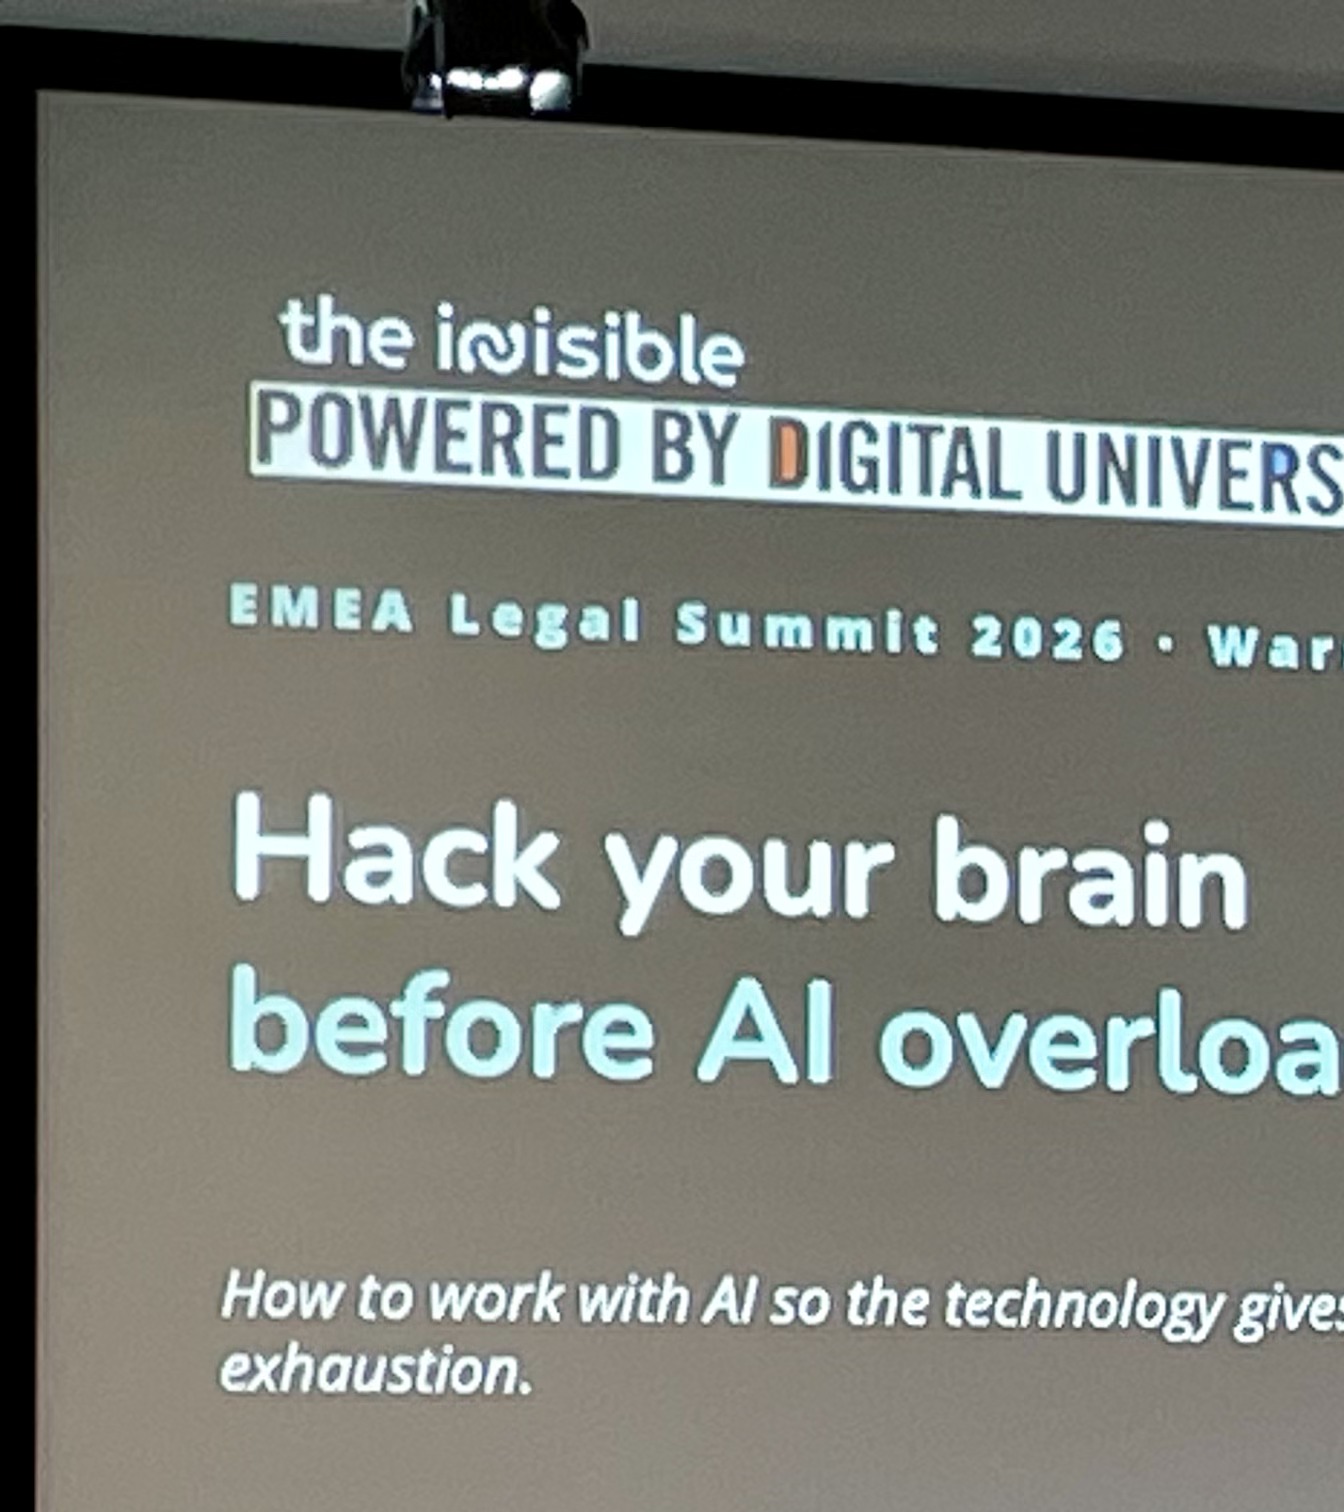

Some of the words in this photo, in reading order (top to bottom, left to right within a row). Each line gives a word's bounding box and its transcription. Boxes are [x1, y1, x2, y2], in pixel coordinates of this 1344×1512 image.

[278, 293, 416, 370] the
[256, 391, 619, 480] POWERED
[652, 408, 740, 485] BY
[769, 416, 1022, 500] DIGITAL
[229, 582, 414, 633] EMEA
[450, 592, 639, 651] Legal
[676, 601, 939, 655] Summit
[971, 614, 1124, 662] 2026
[234, 790, 562, 911] Hack
[603, 832, 897, 938] your
[935, 813, 1248, 931] brain
[231, 962, 655, 1081] before
[696, 976, 833, 1085] AI
[220, 1267, 348, 1321] How
[358, 1273, 414, 1322] to
[429, 1268, 567, 1324] work
[578, 1270, 691, 1325] with
[699, 1274, 760, 1326] AI
[768, 1285, 832, 1326] so
[846, 1273, 931, 1328] the
[944, 1275, 1229, 1344] technology
[219, 1339, 533, 1396] exhaustion.
